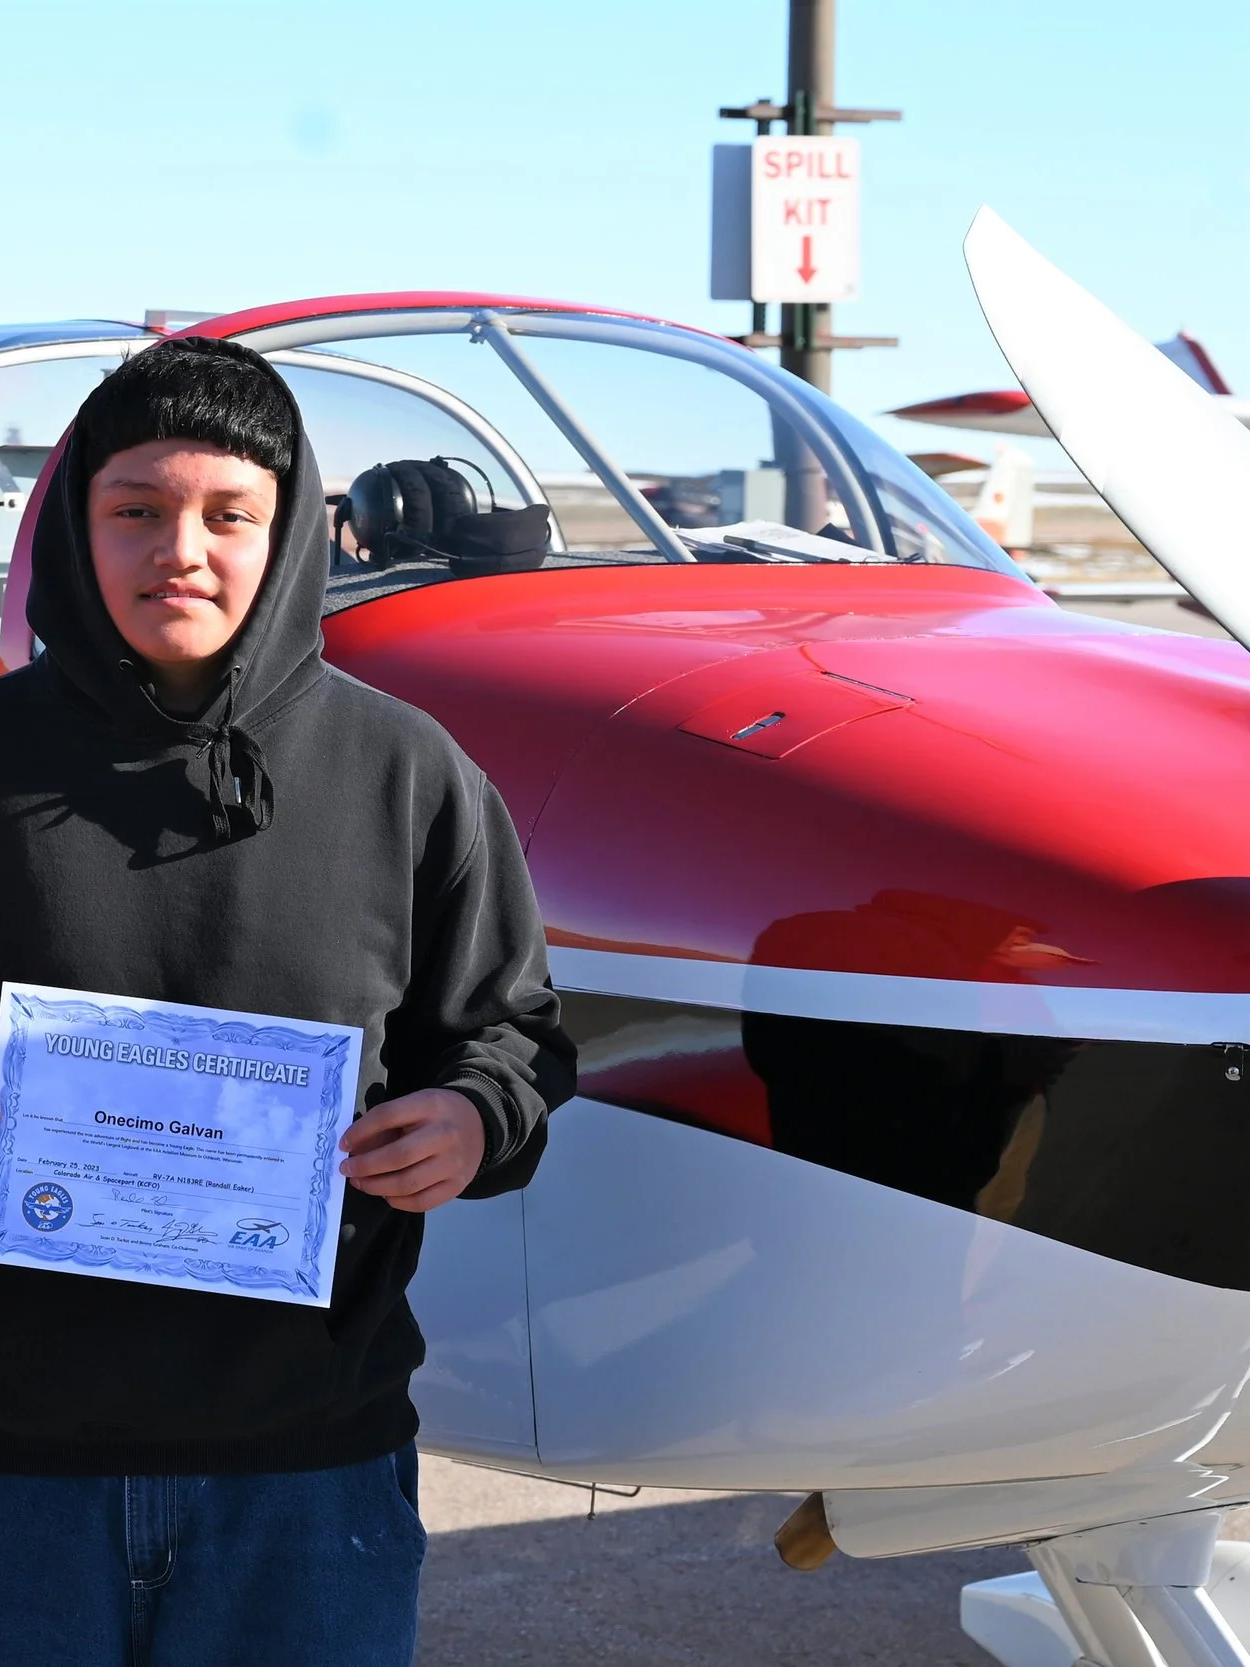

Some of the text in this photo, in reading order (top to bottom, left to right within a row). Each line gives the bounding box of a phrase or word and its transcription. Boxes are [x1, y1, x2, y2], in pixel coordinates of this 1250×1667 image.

[764, 150, 853, 179] SPILL
[783, 198, 832, 225] KIT
[45, 1032, 310, 1087] YOUNG EAGLES CERTIFICATE
[94, 1110, 164, 1132] Onecimo
[169, 1120, 223, 1140] Galvan
[38, 1158, 67, 1168] February
[83, 1164, 100, 1172] 2023
[153, 1173, 175, 1182] RV-7A
[206, 1180, 230, 1190] (Randall
[233, 1184, 255, 1193] Eaker)
[54, 1170, 81, 1179] Colorado
[103, 1176, 135, 1186] Spaceport
[137, 1180, 160, 1189] (KCFO)
[28, 1186, 68, 1204] YOUNG EAGLES
[229, 1231, 278, 1249] EAA
